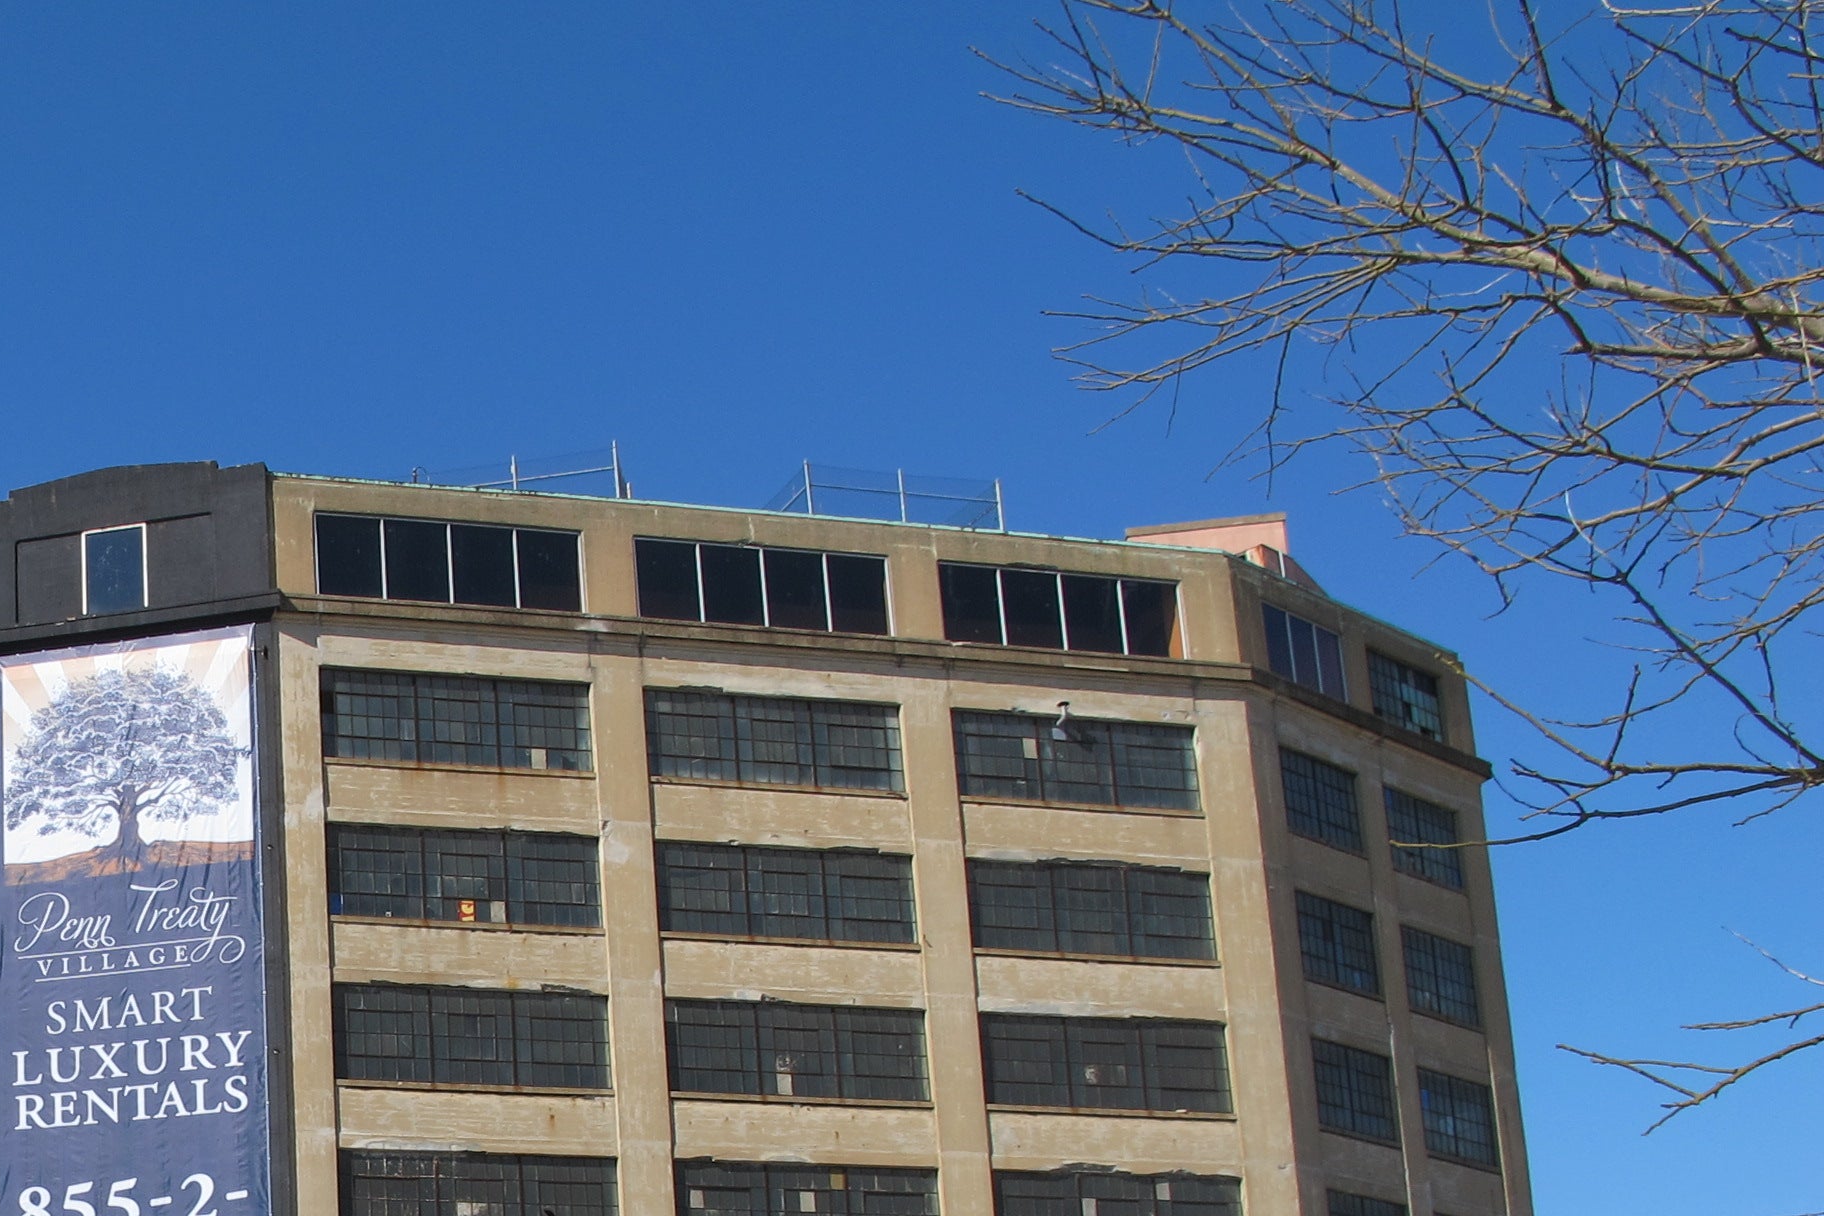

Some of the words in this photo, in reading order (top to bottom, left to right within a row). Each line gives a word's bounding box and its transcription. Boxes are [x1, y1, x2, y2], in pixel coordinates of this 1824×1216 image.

[14, 892, 116, 952] Penn
[130, 879, 246, 964] Treaty
[37, 946, 190, 977] VILLAGE
[46, 985, 213, 1035] SMART
[12, 1030, 252, 1086] LUXURY
[14, 1075, 249, 1130] RENTALS
